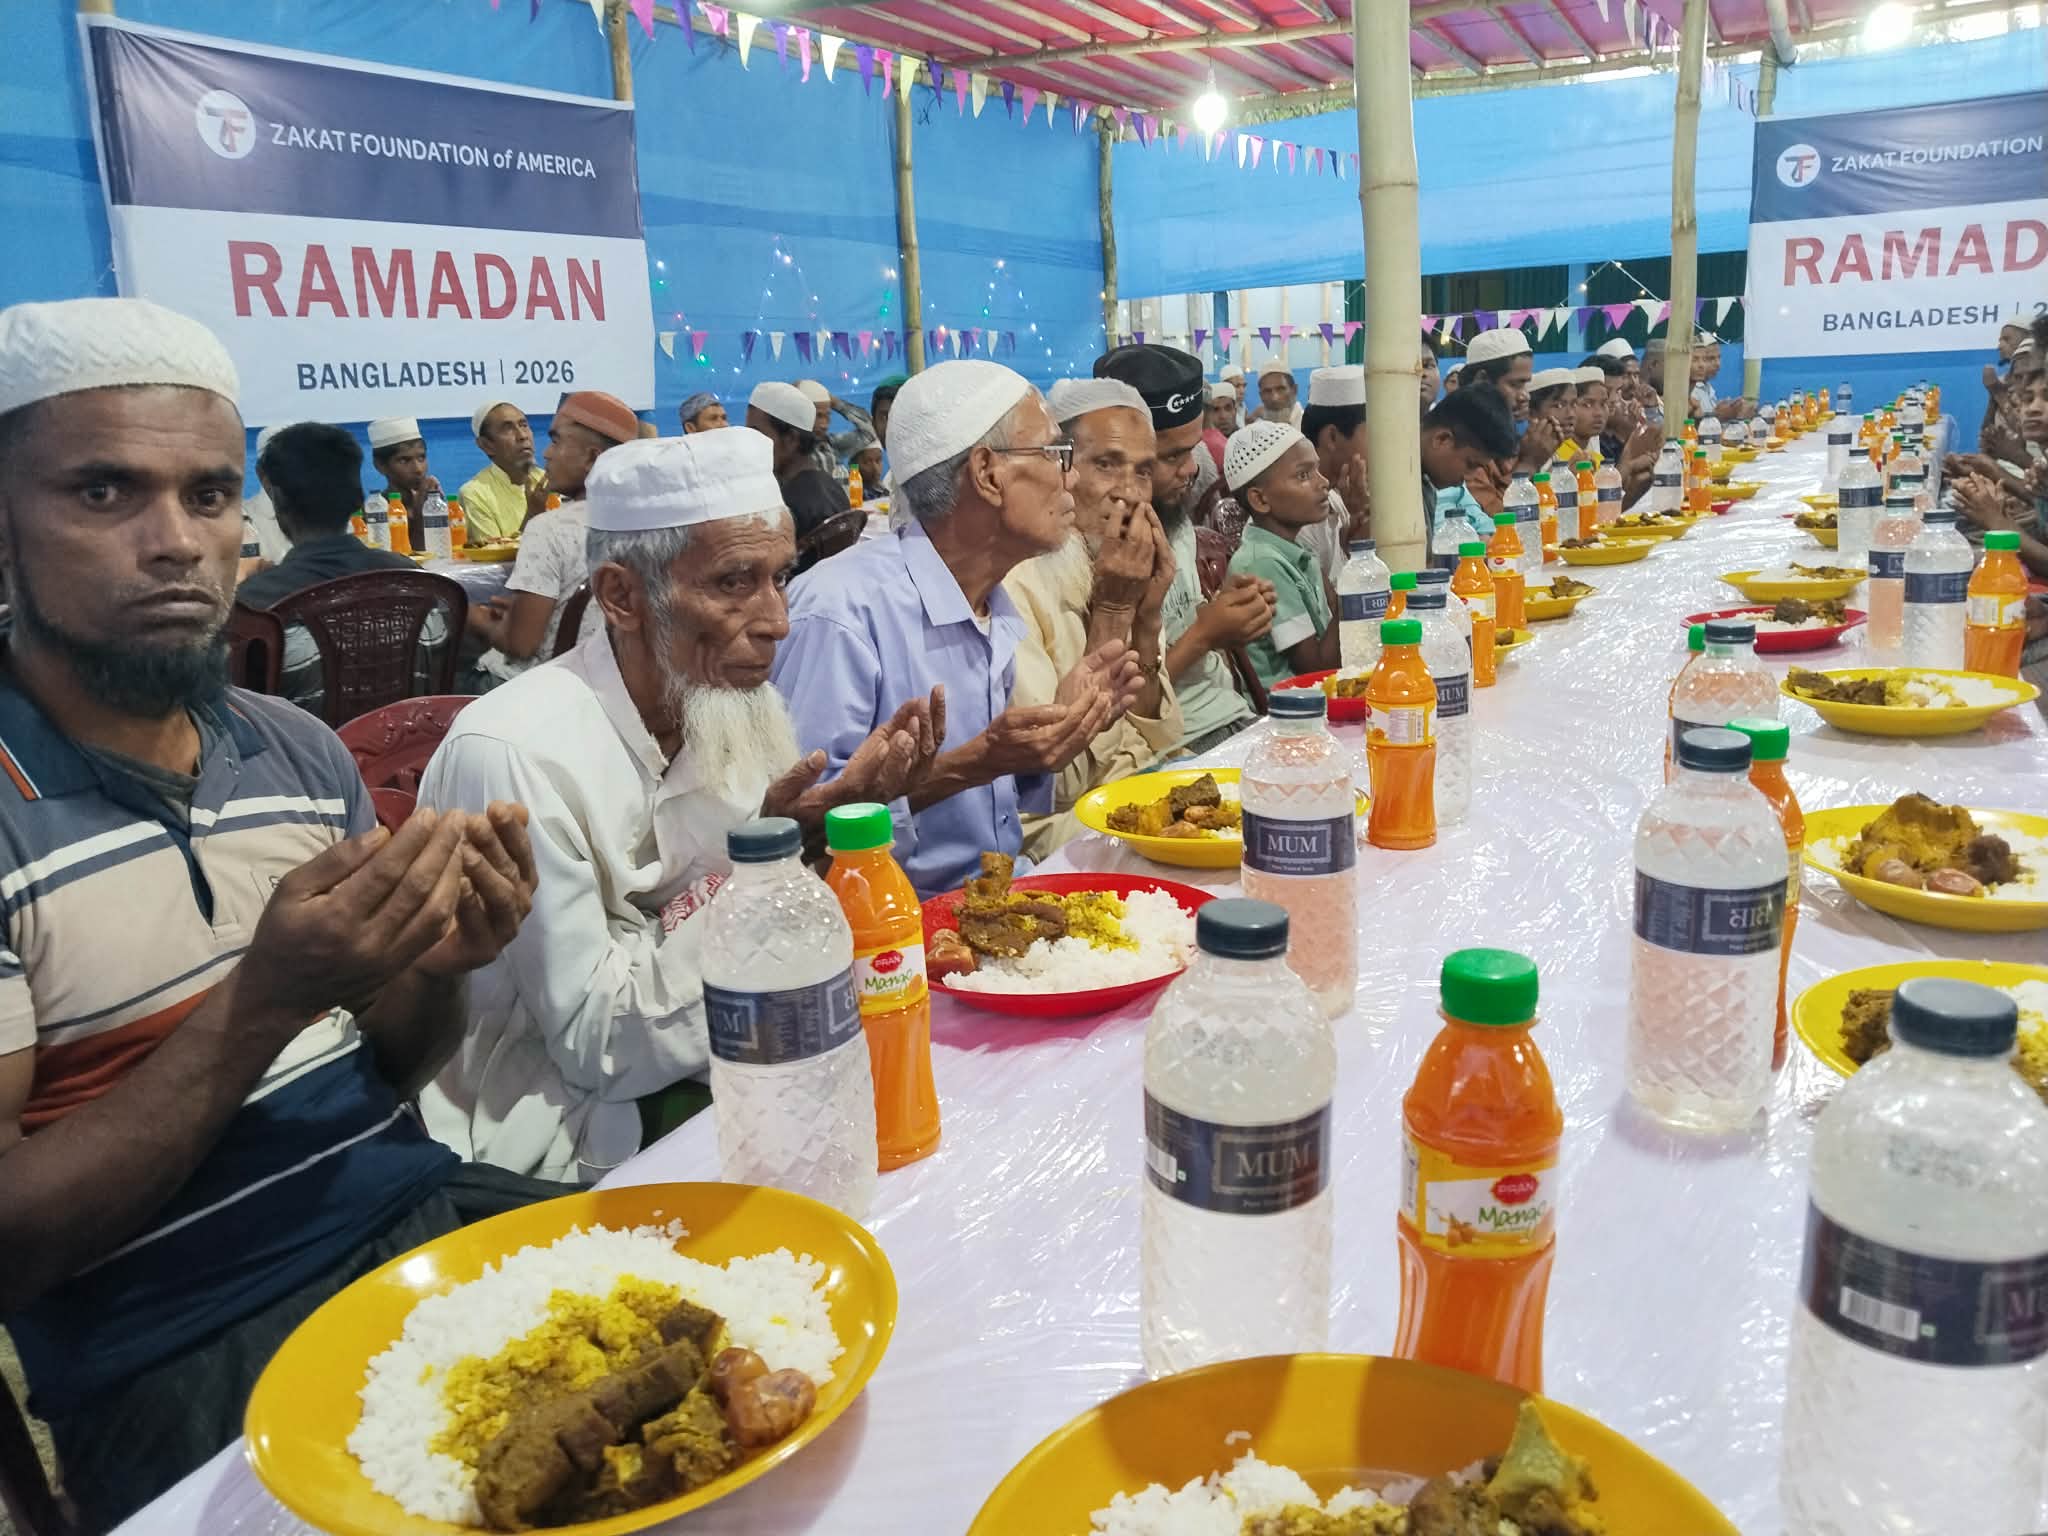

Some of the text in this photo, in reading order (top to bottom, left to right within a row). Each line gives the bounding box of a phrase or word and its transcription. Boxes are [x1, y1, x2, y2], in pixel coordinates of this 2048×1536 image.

[270, 122, 597, 179] ZAKAT FOUNDATION of AMERICA
[1831, 135, 2044, 173] ZAKAT FOUNDATION
[227, 240, 607, 322] RAMADAN
[1823, 304, 1999, 332] BANGLADESH
[296, 360, 575, 391] BANGLADESH 2026
[1266, 834, 1319, 853] MUM
[1234, 1141, 1313, 1177] MUM
